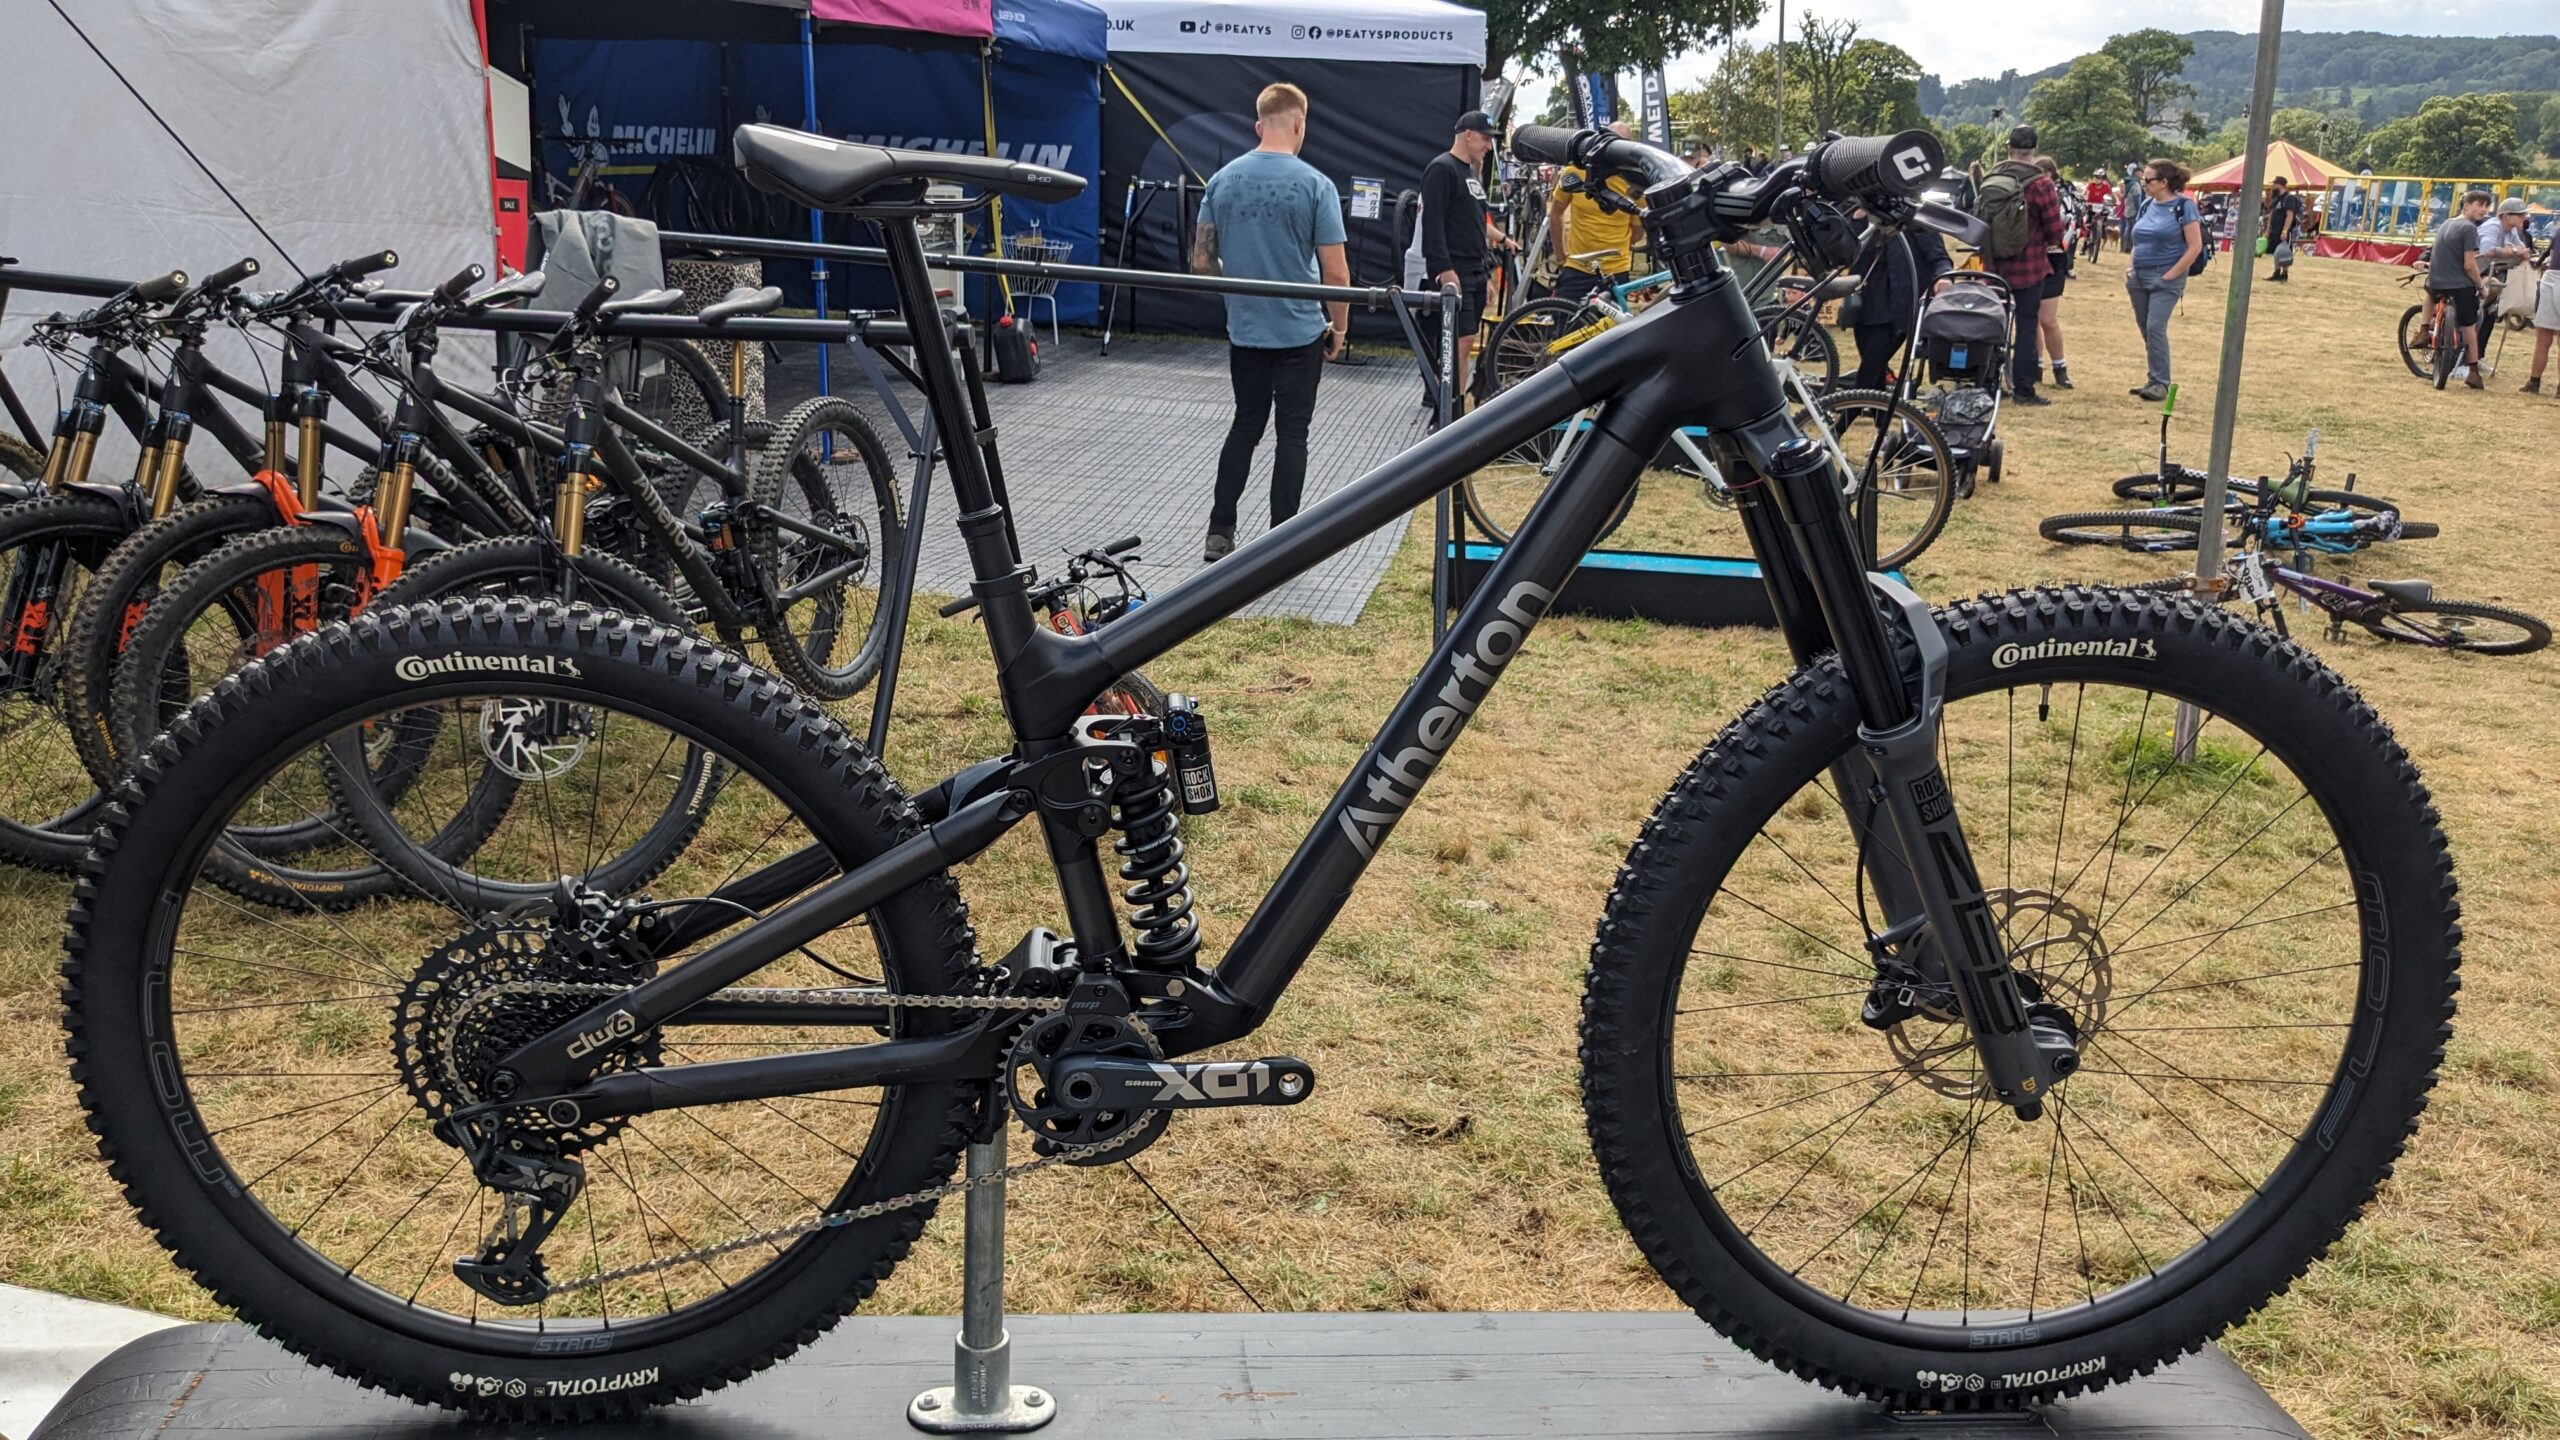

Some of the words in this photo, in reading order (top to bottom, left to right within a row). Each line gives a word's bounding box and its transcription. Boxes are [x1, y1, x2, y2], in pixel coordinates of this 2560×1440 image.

[1215, 22, 1272, 35] @PEATYS
[1326, 28, 1454, 41] @PEATYSPRODUCTS
[610, 125, 717, 155] MICHELIN
[503, 200, 516, 209] SALE
[1991, 637, 2139, 669] Continental
[395, 650, 556, 682] Continental
[1337, 580, 1555, 861] Atherton
[1183, 767, 1209, 786] ROCK
[1187, 784, 1212, 801] SHOX
[1071, 1000, 1101, 1011] mrp
[143, 888, 227, 1185] FLOW
[1124, 1079, 1162, 1087] SRAM
[546, 1366, 660, 1397] KRYPTOTAL
[2001, 1355, 2107, 1389] KRYPTOTAL
